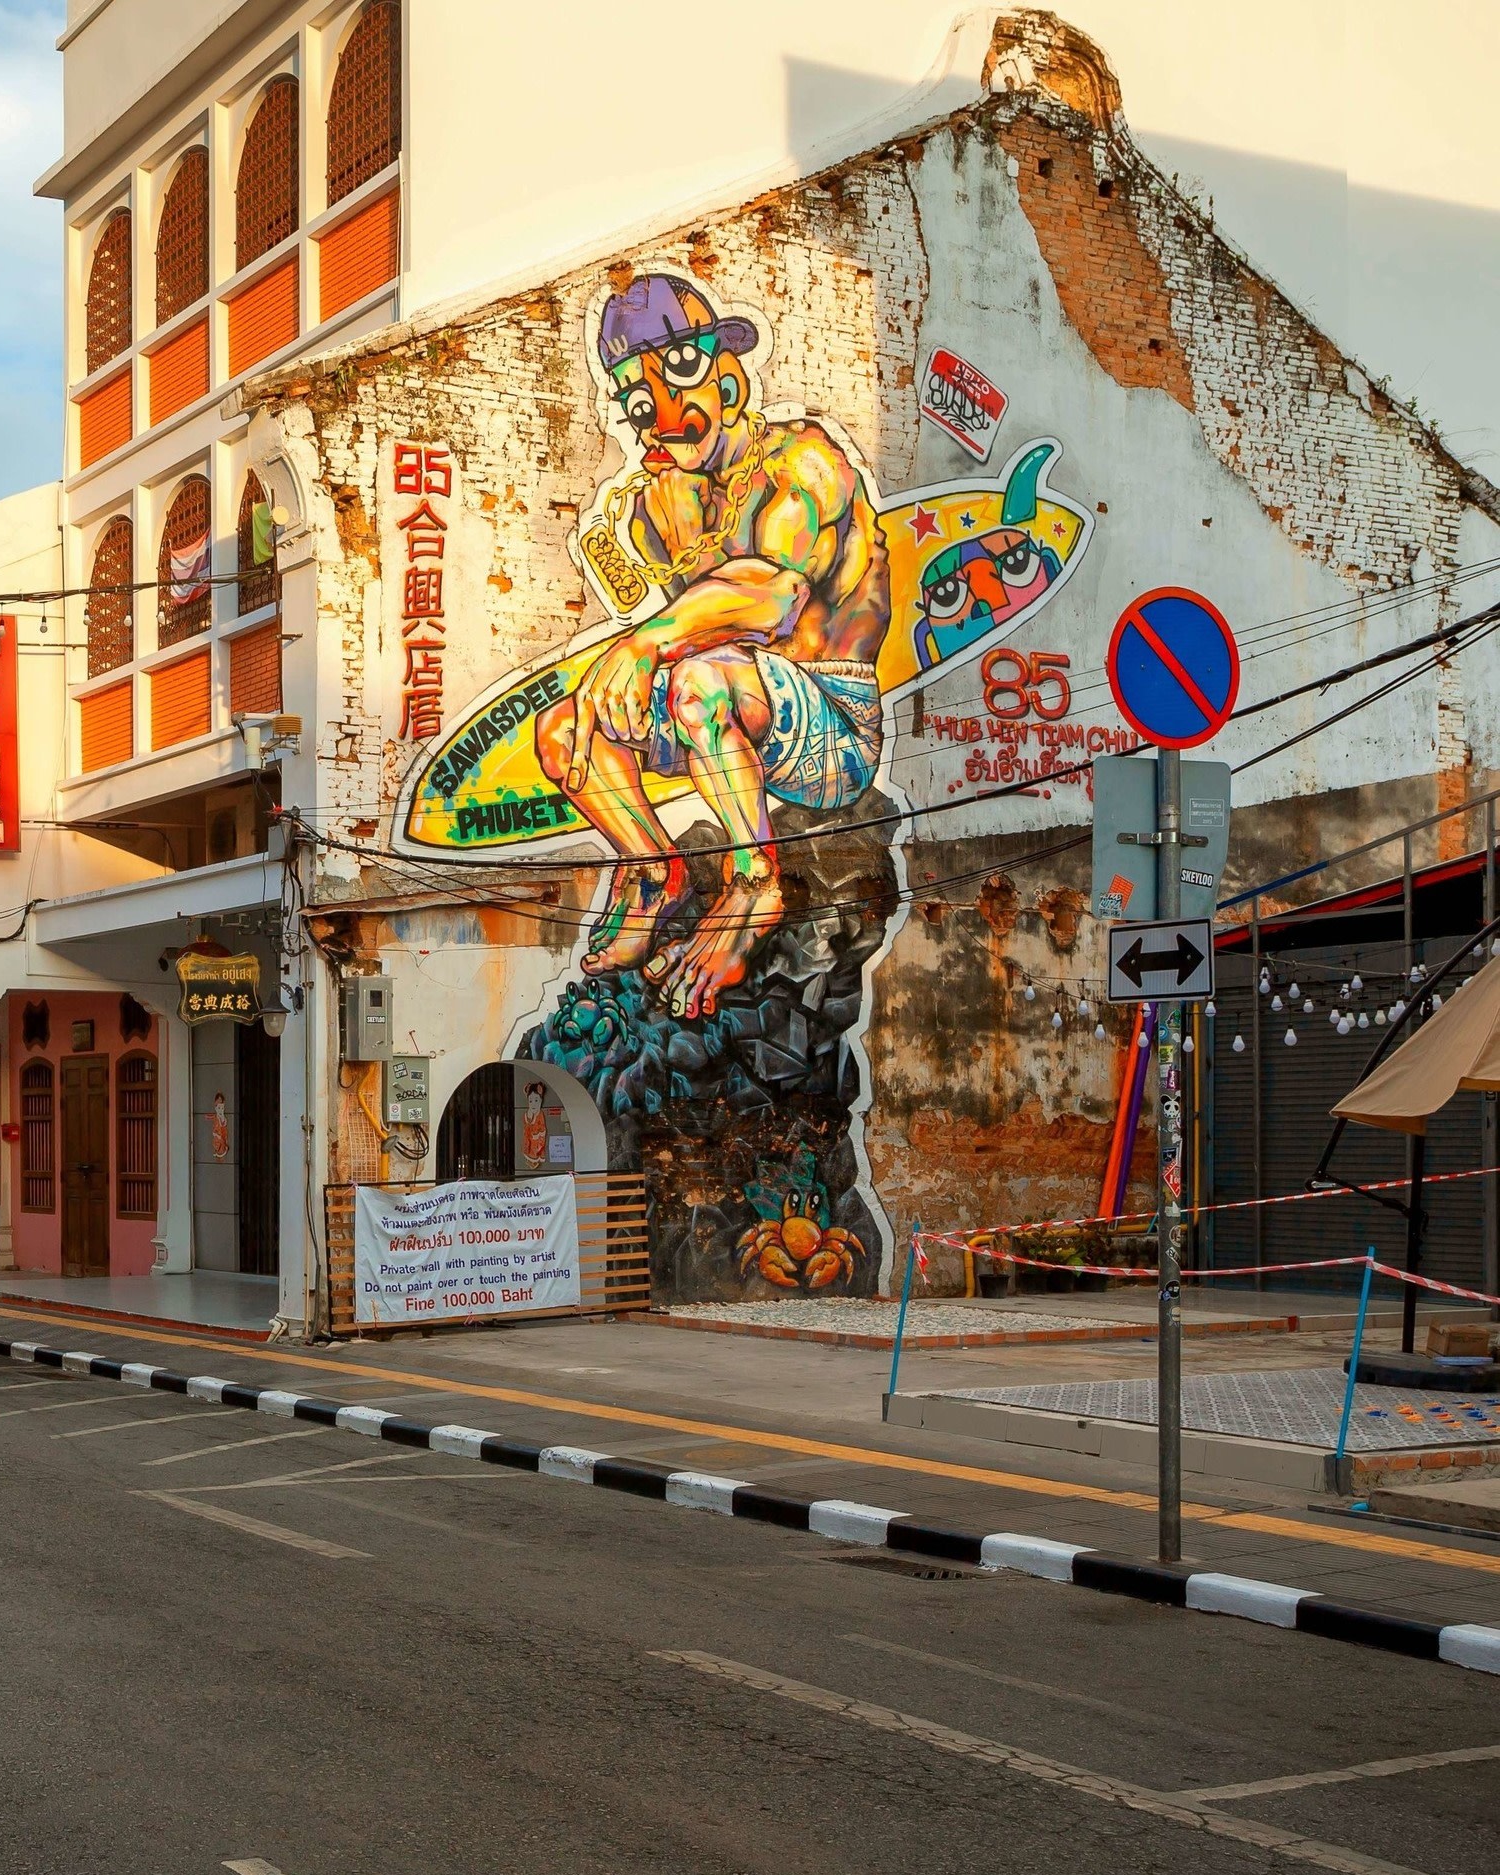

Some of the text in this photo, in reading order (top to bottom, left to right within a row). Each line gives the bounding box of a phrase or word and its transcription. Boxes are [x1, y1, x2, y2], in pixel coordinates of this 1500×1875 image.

[980, 647, 1072, 721] 85
[429, 670, 565, 799] SAWASDEE
[986, 718, 1029, 745] HIN
[1031, 723, 1085, 748] TIAM
[457, 793, 571, 840] PHUKET
[1180, 869, 1213, 887] SKEYLOO
[458, 1229, 511, 1245] 100,000
[517, 1227, 545, 1242] บาท
[380, 1251, 557, 1275] Private wall with painting by artist
[364, 1268, 571, 1294] Do not paint over or touch the painting
[405, 1288, 534, 1311] Fine 100,000 Baht
